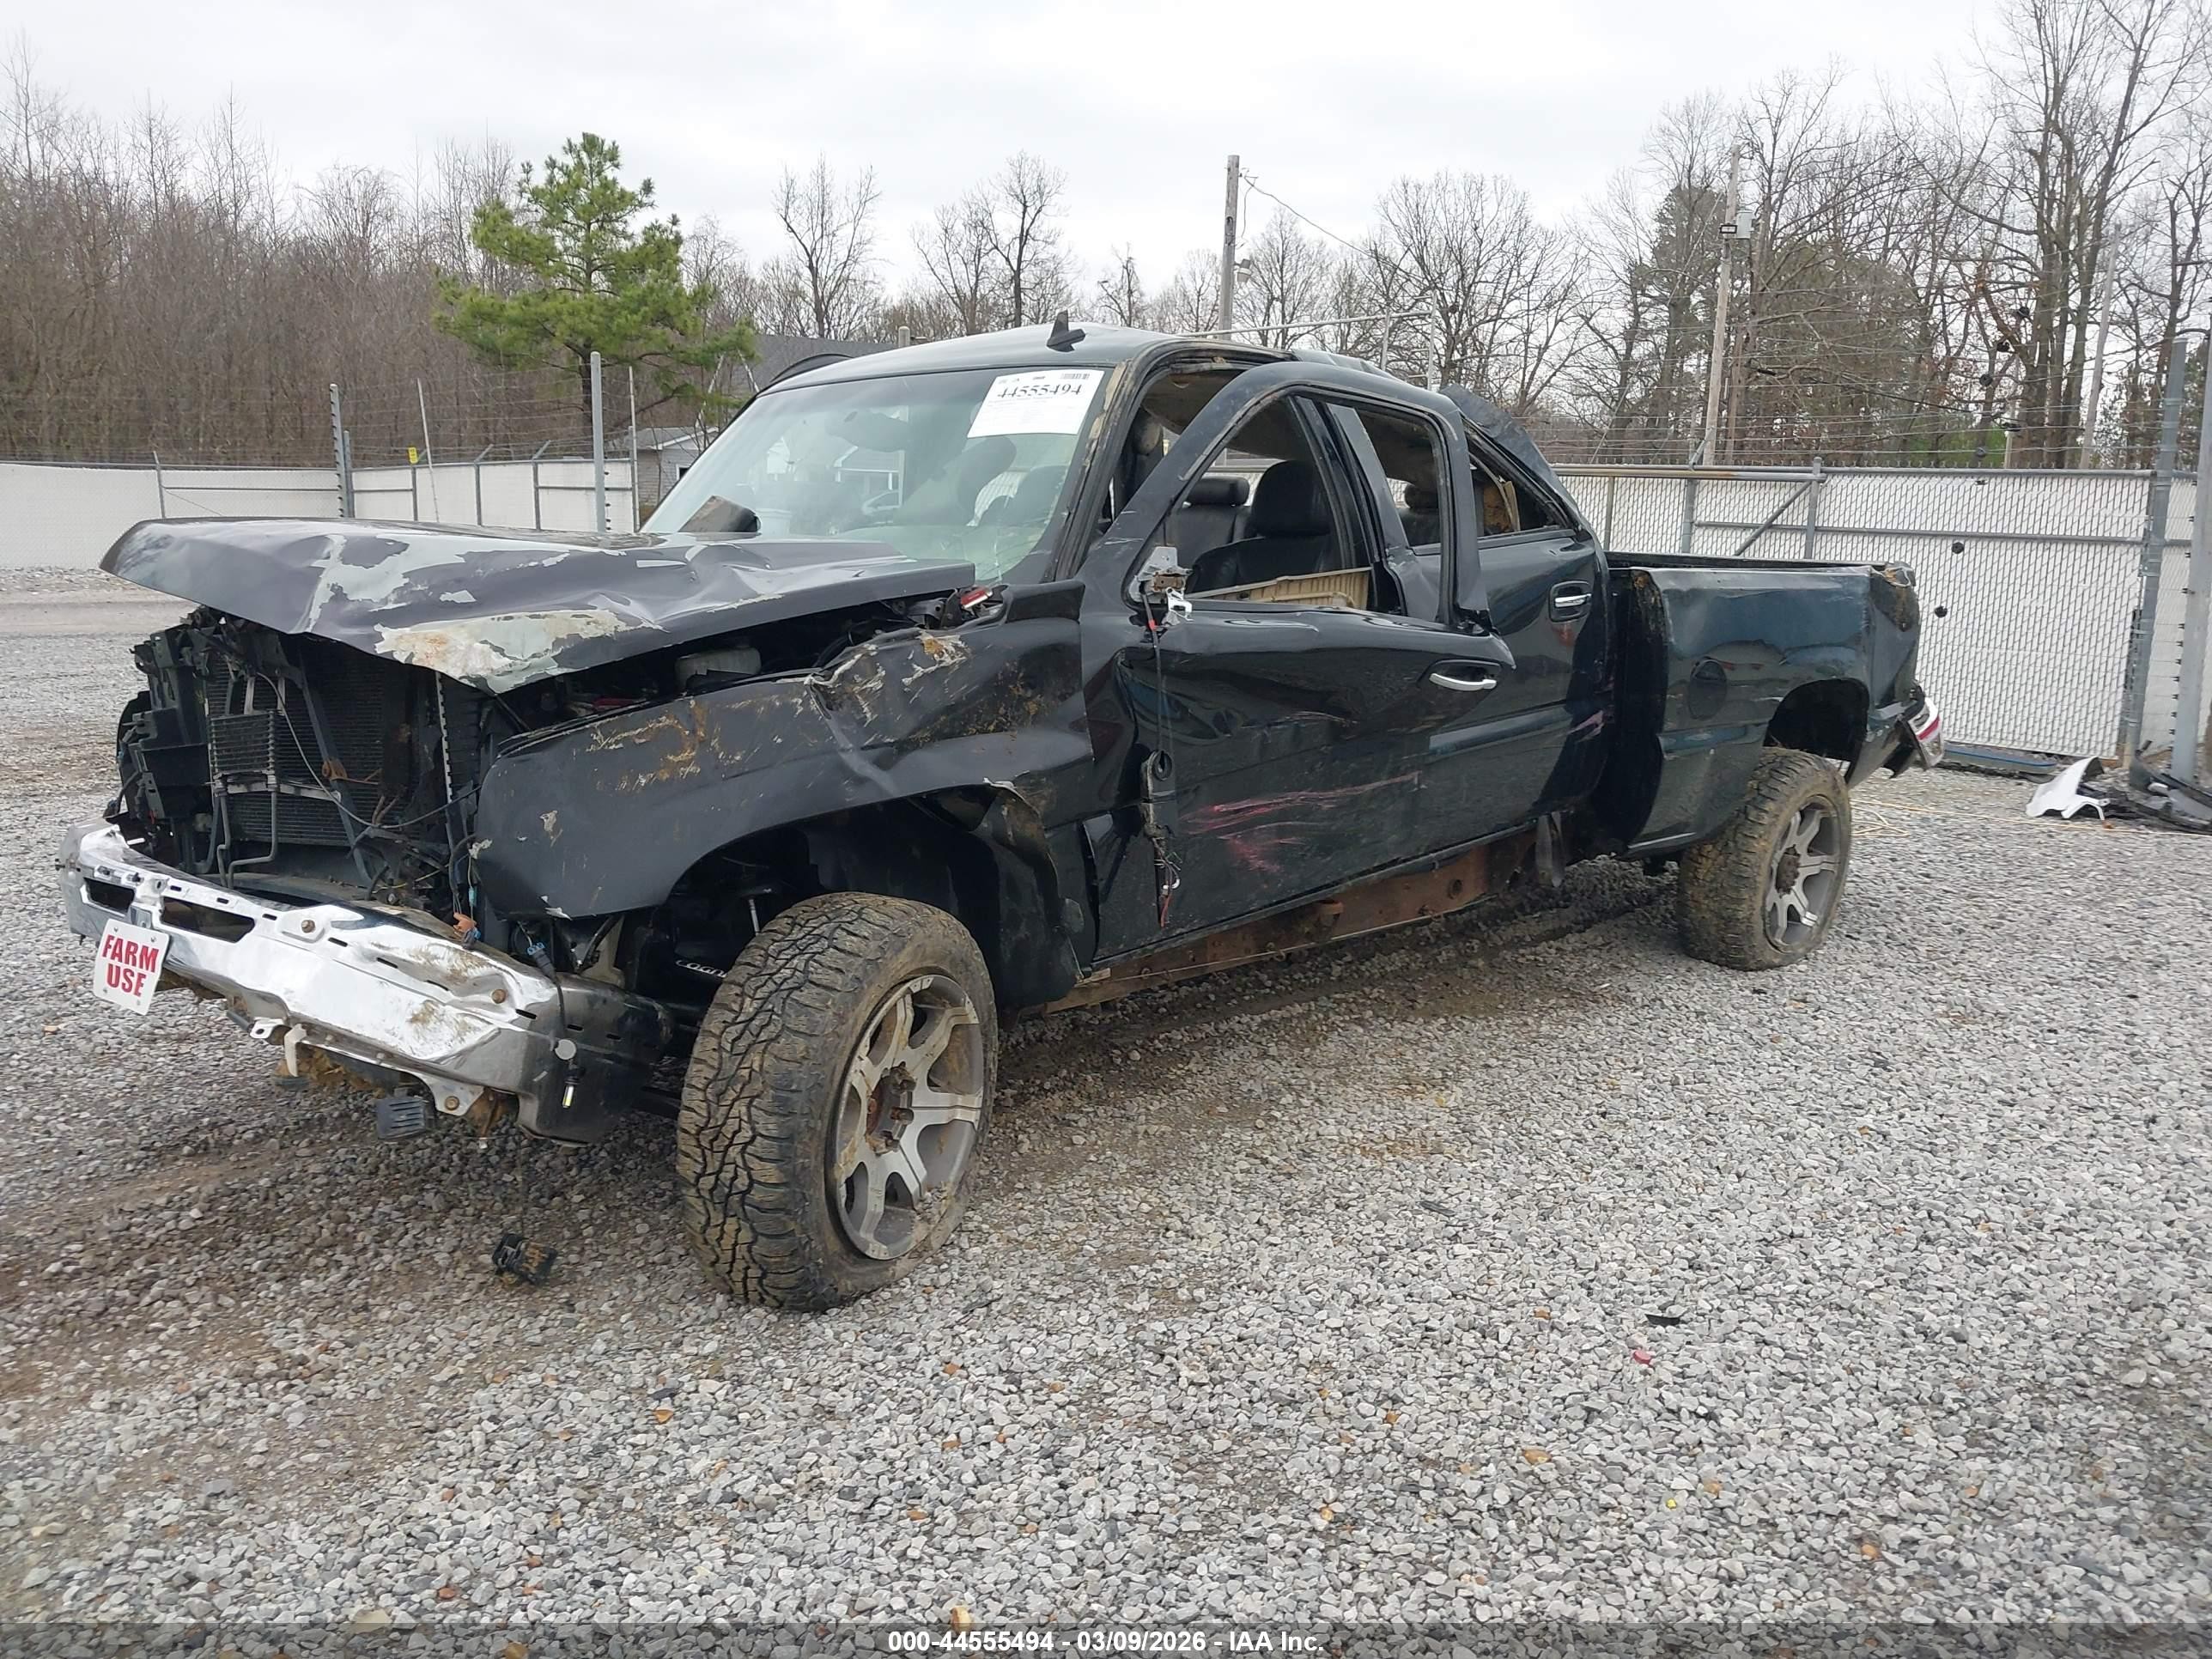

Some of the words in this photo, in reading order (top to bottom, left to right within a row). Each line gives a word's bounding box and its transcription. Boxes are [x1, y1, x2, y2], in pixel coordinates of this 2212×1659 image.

[997, 384, 1082, 398] 44555494
[102, 934, 159, 973] FARM
[106, 963, 147, 997] USE
